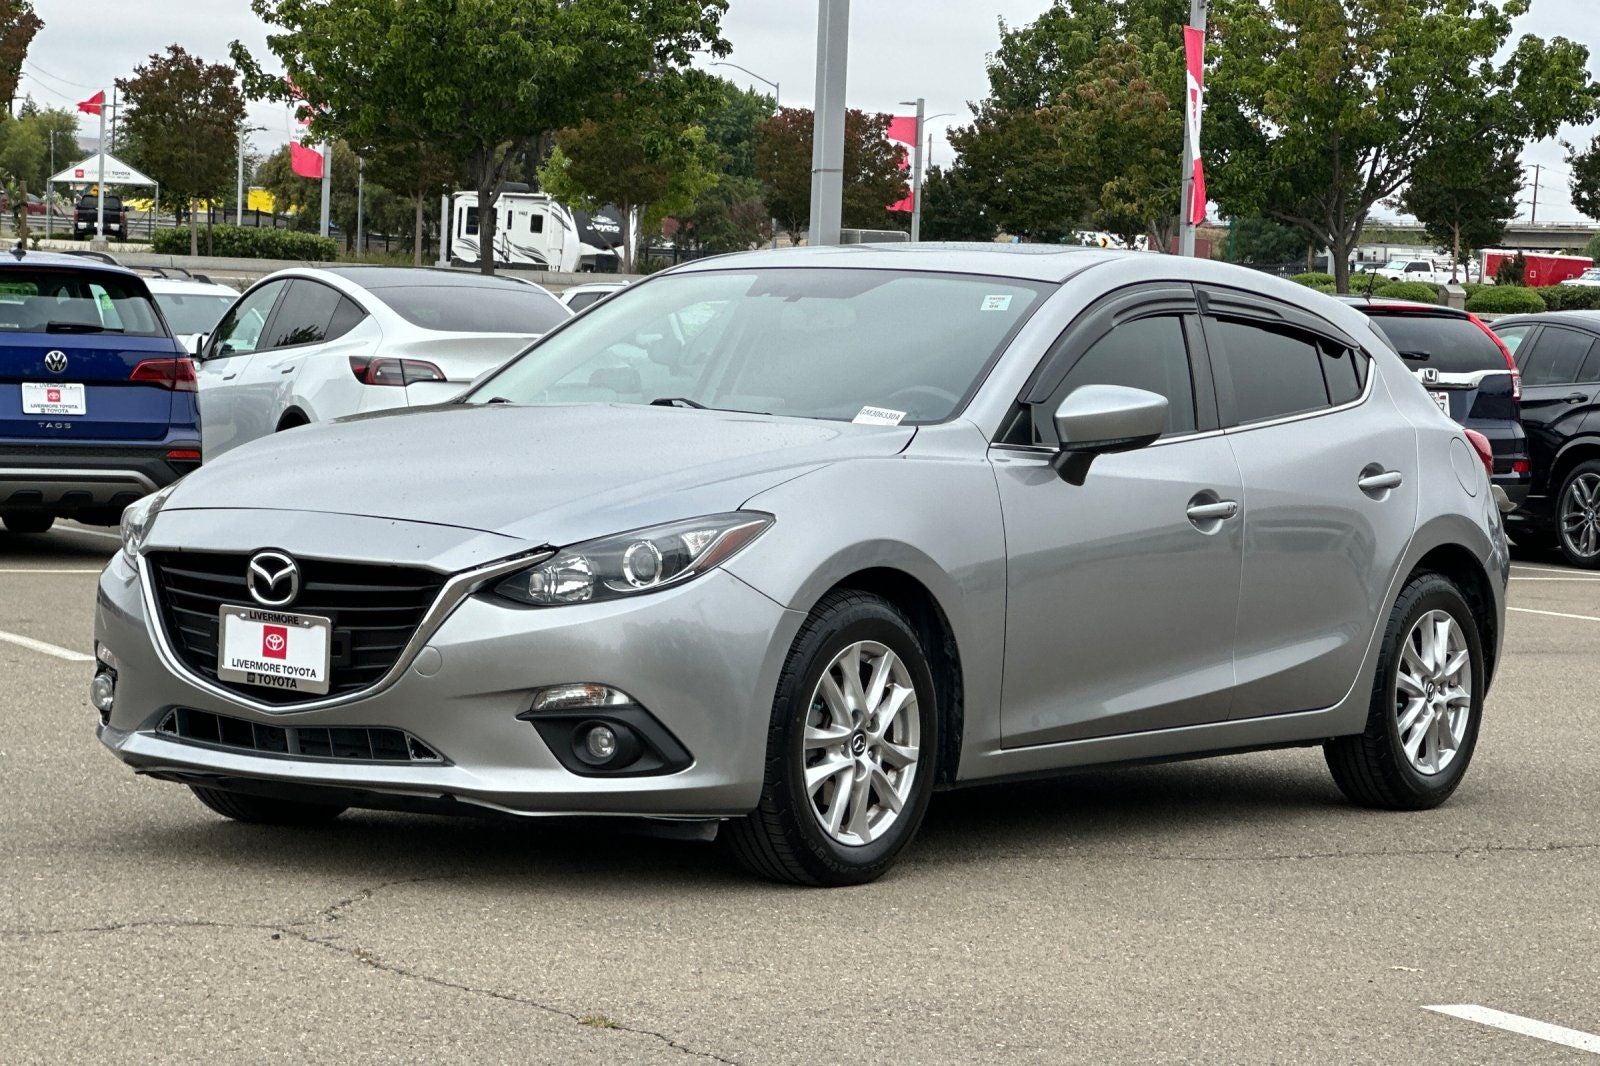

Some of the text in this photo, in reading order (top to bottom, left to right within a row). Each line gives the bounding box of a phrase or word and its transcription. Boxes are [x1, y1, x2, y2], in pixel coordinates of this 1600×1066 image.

[249, 611, 299, 625] LIVERMORE
[232, 658, 317, 678] LIVERMORE TOYOTA
[258, 674, 298, 689] TOYOTA
